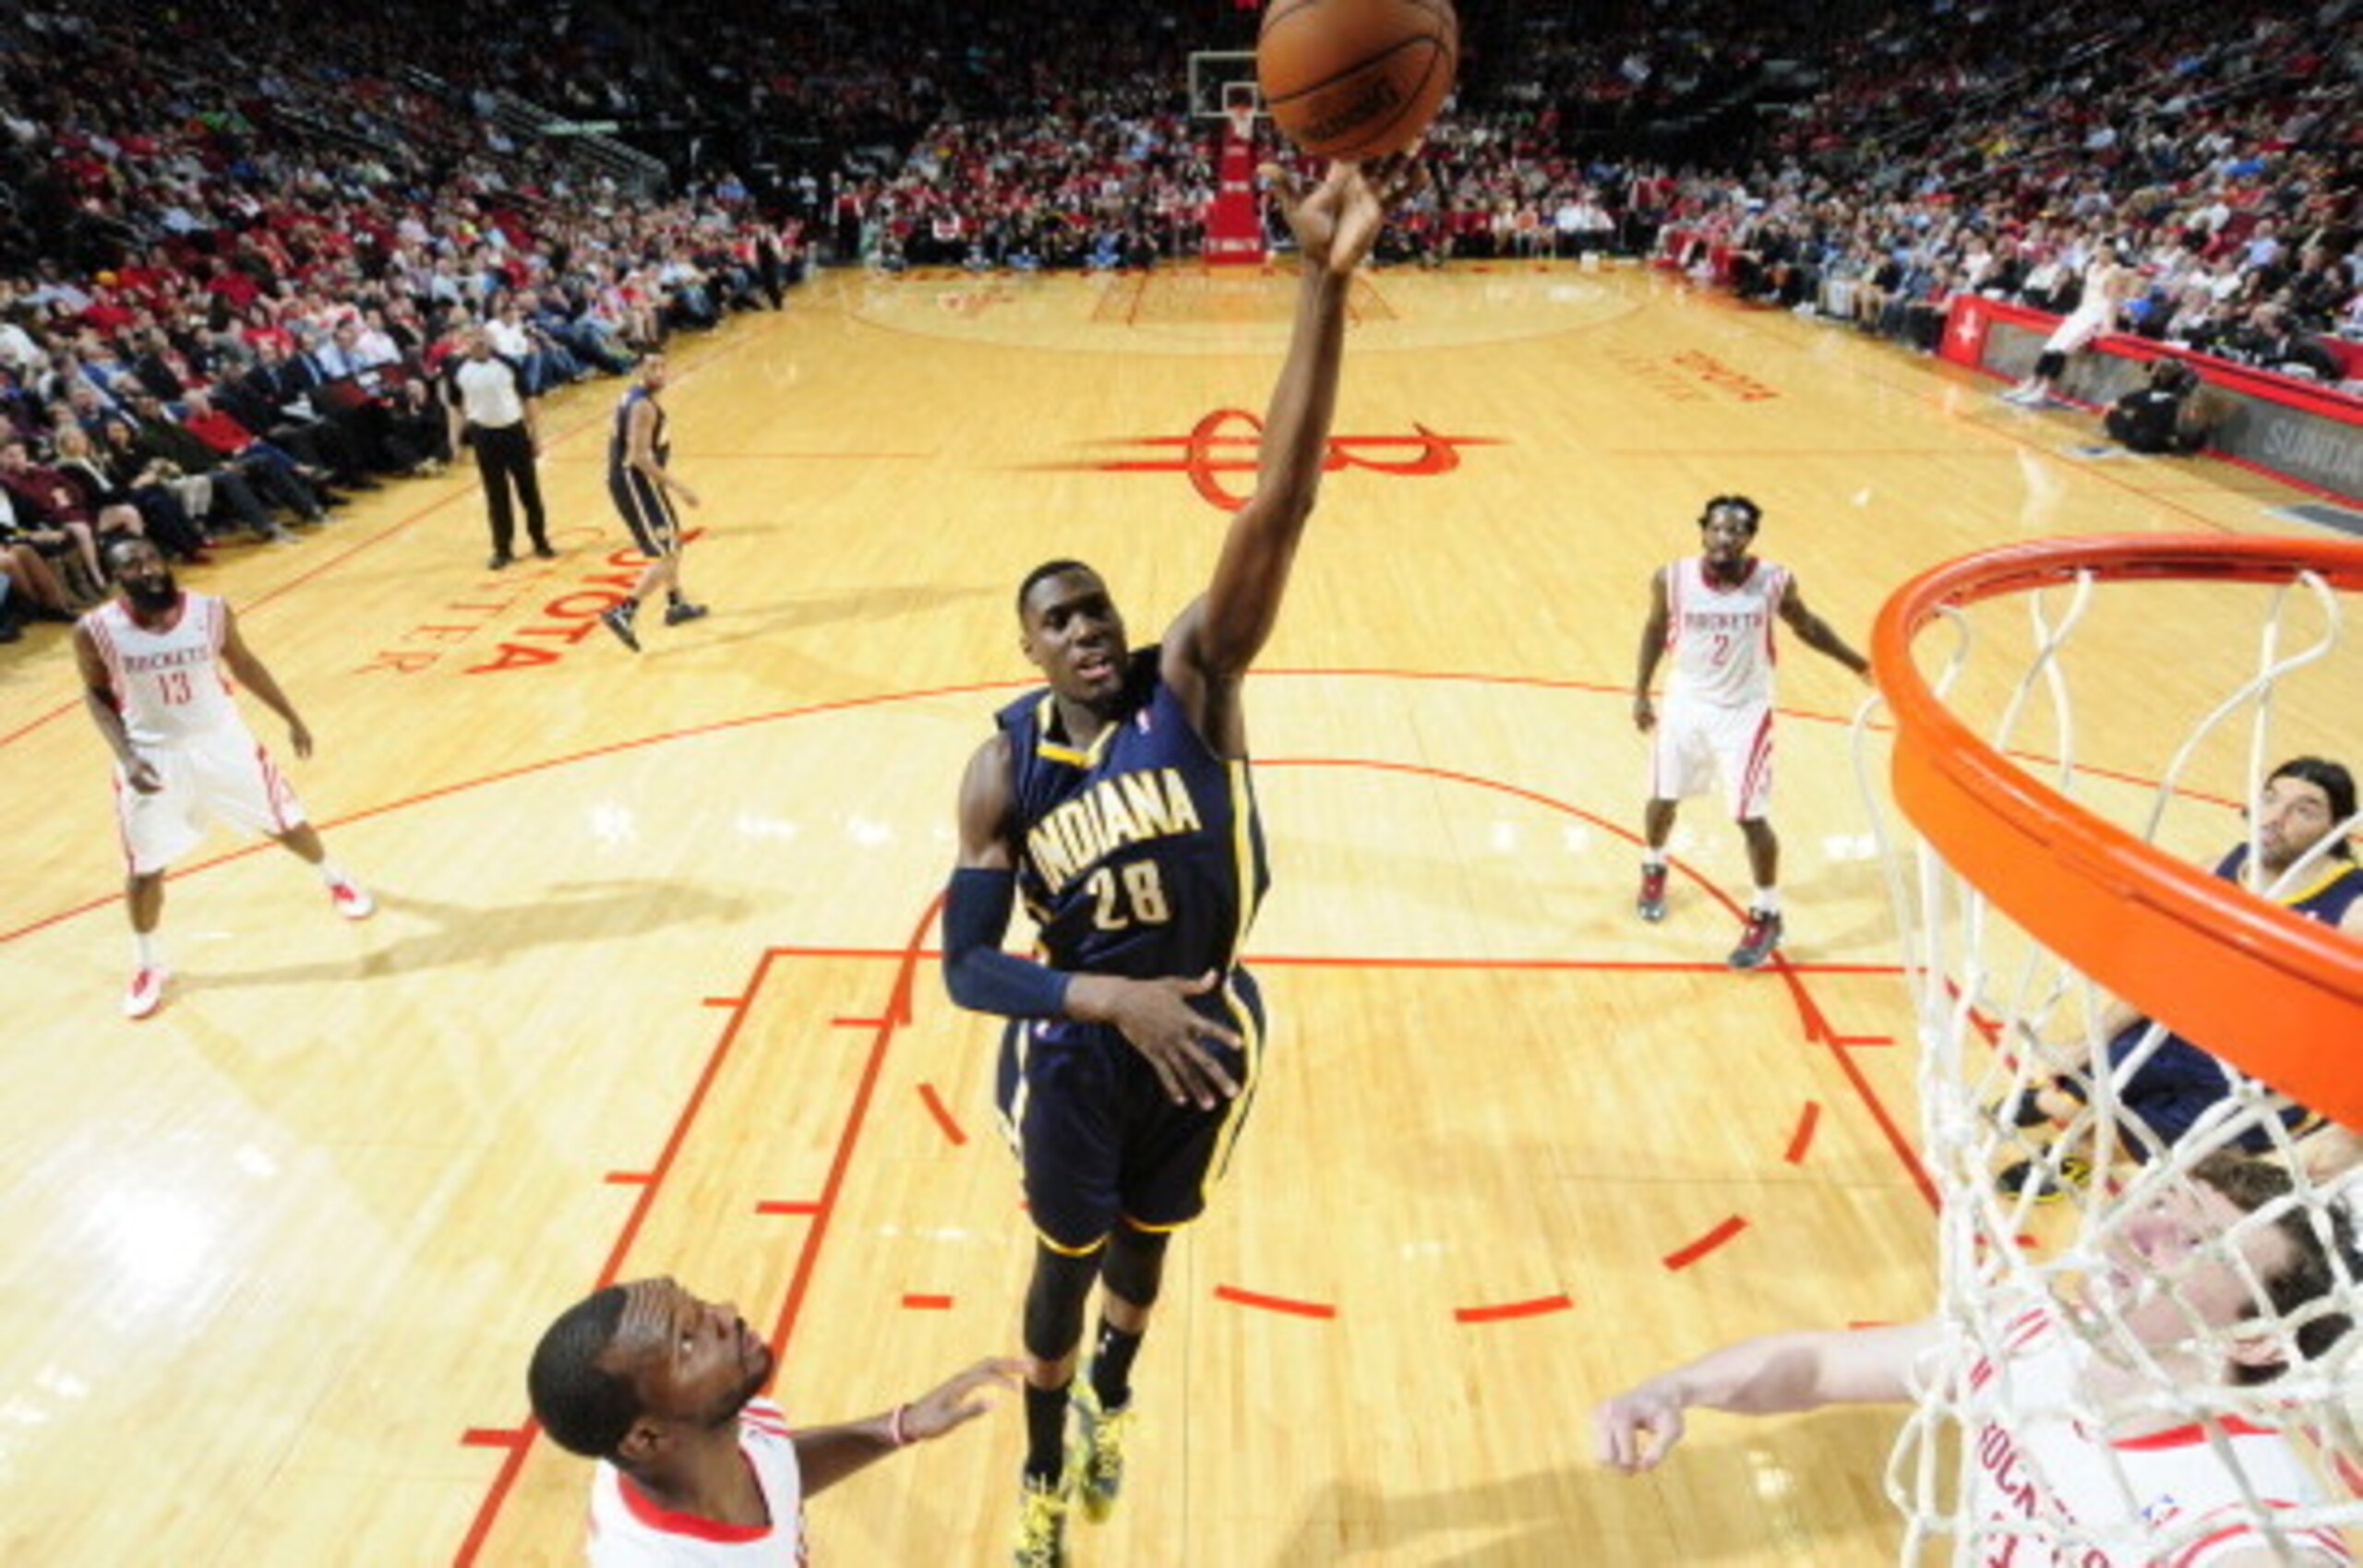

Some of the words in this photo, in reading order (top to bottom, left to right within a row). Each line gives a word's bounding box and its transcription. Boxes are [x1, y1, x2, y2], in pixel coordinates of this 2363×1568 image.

[1711, 633, 1730, 667] 2
[157, 670, 192, 706] 13
[1026, 768, 1202, 896] INDIANA
[1086, 858, 1171, 930] 28
